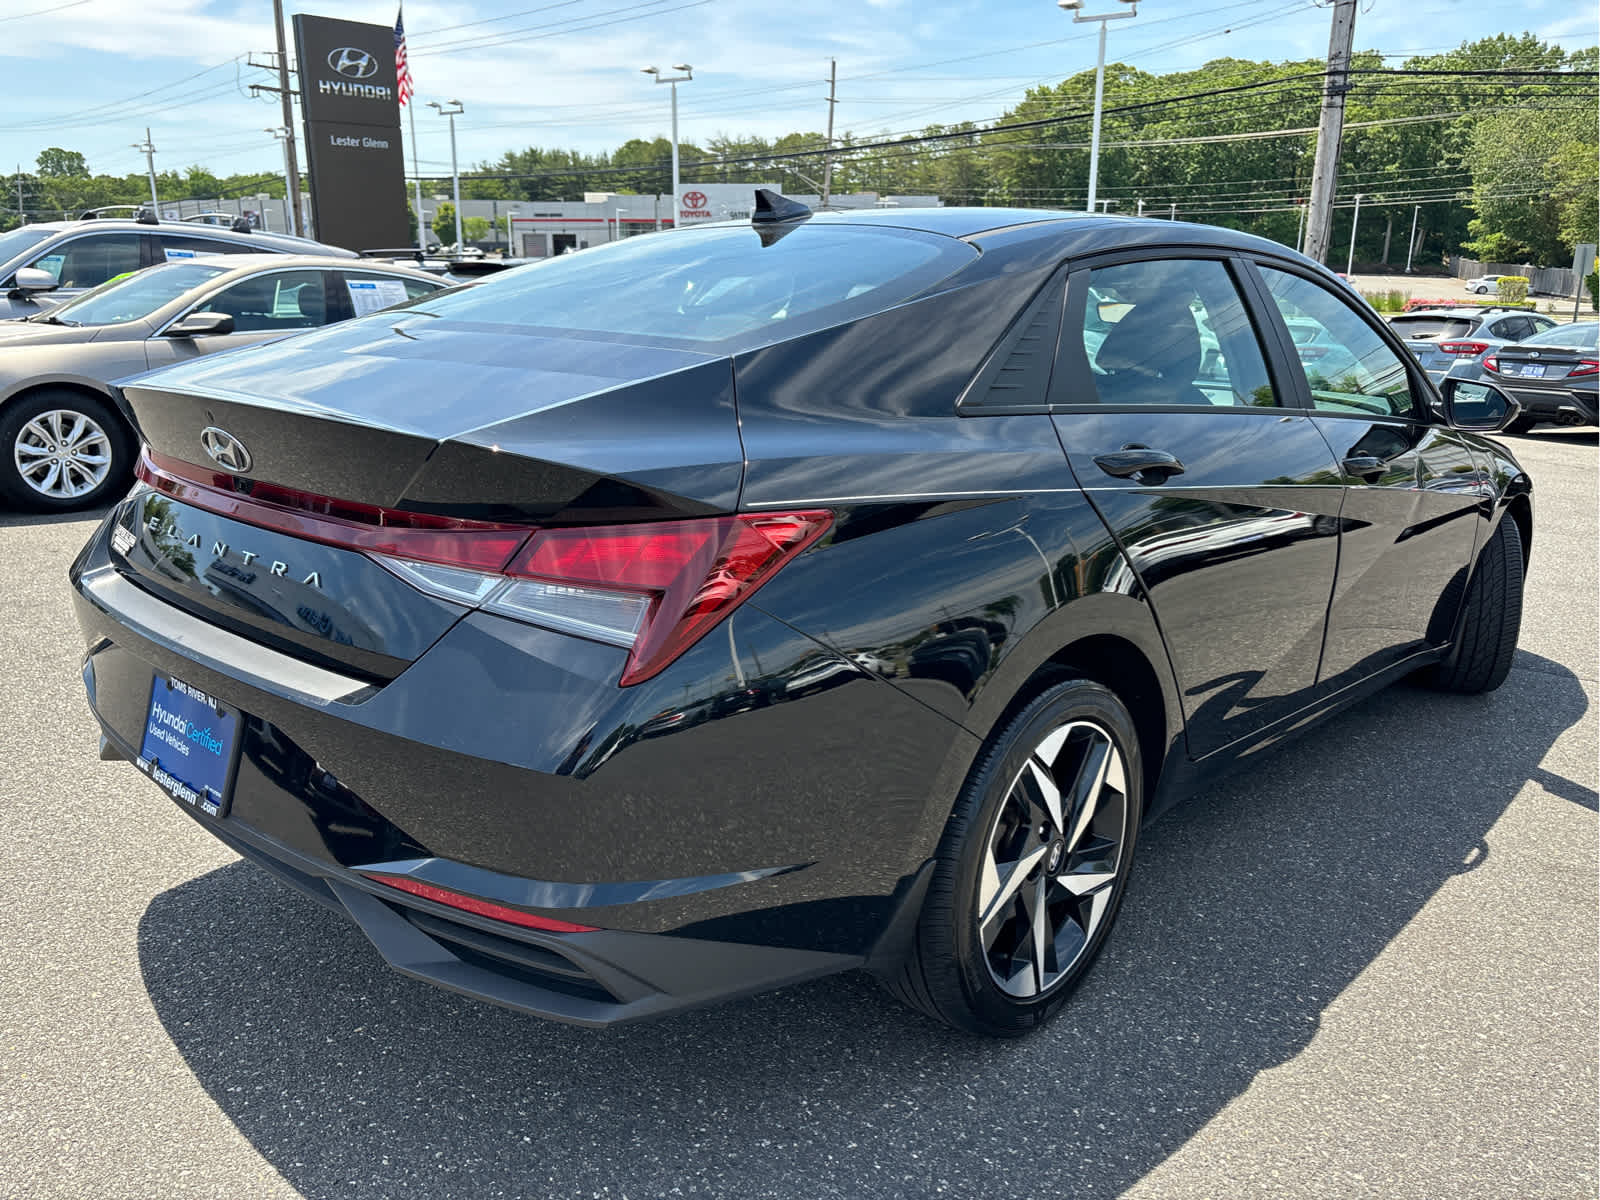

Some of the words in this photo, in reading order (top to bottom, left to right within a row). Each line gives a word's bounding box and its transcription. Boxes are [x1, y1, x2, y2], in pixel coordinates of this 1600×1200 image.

[319, 79, 391, 100] HYUNDAI
[330, 135, 360, 147] Lester
[362, 137, 389, 149] Glenn
[680, 210, 712, 218] TOYOTA
[150, 516, 322, 588] ELANTRA
[171, 676, 187, 695] TOMS
[208, 695, 217, 710] NJ
[149, 721, 166, 741] Used
[165, 730, 190, 756] Vehicles
[152, 765, 197, 806] lesterglenn
[201, 801, 217, 817] .com
